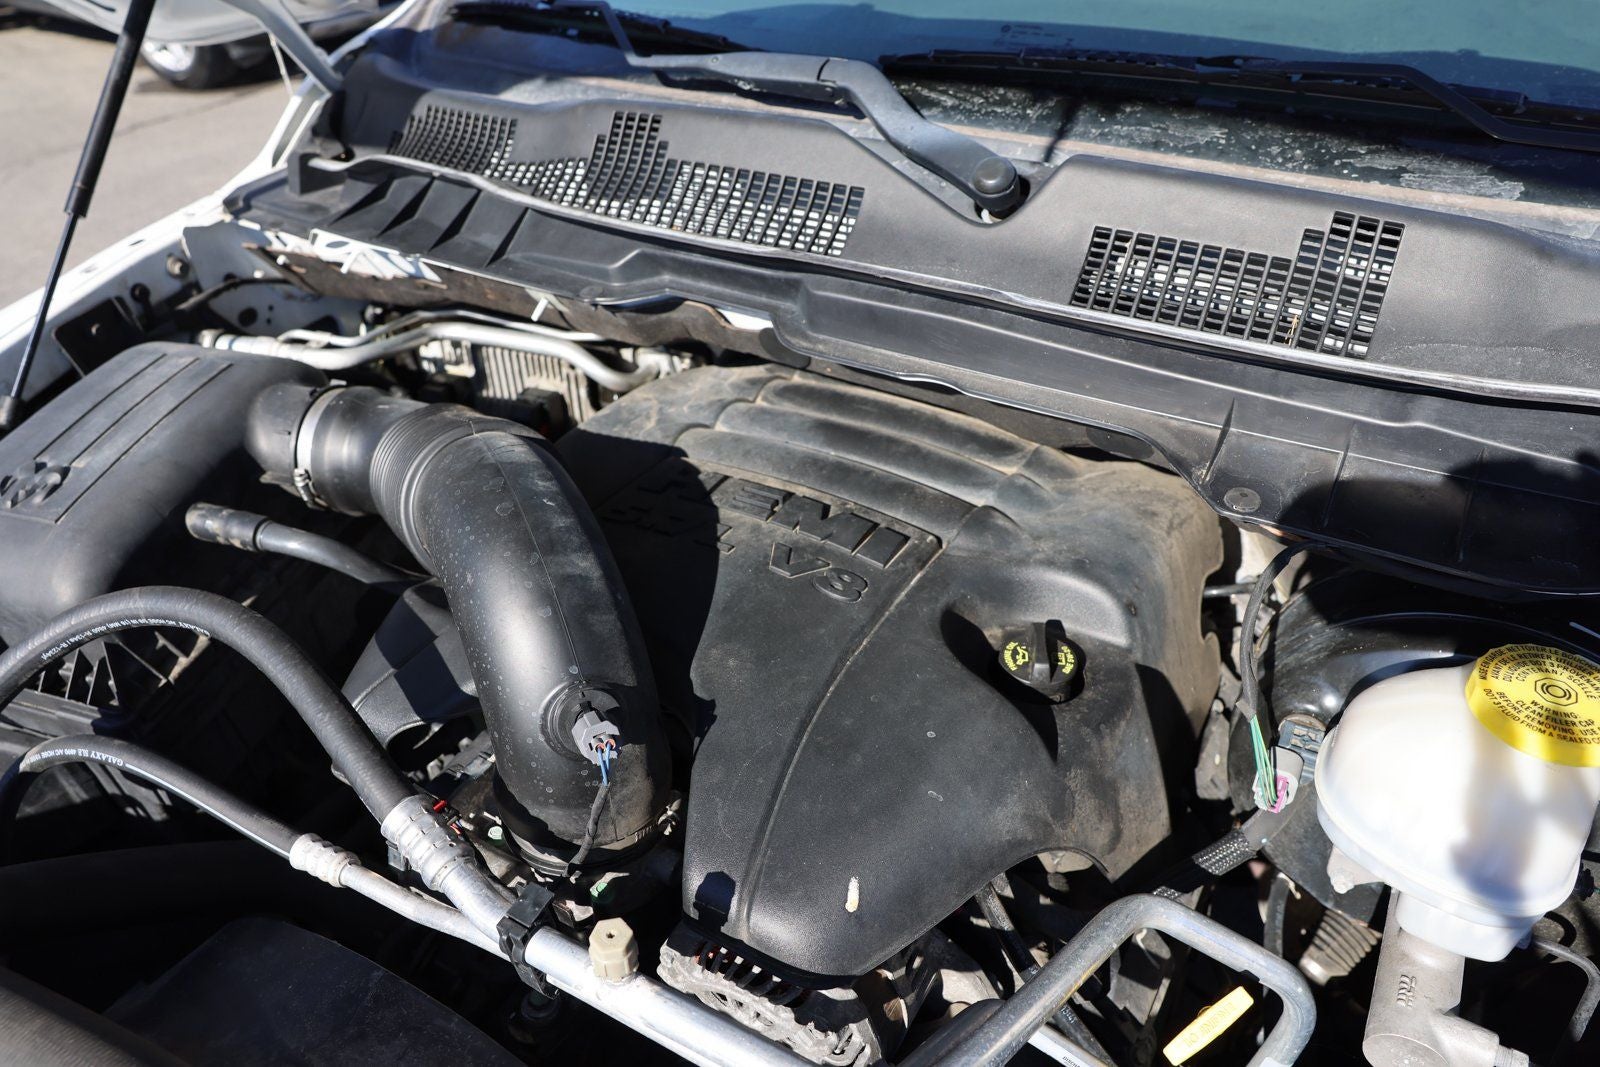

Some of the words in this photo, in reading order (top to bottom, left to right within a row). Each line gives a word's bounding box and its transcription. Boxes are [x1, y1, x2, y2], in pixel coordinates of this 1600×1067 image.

[769, 541, 868, 604] V8
[1006, 642, 1018, 650] OIL
[1004, 650, 1016, 671] ENGINE
[1062, 663, 1074, 674] SAE
[1556, 657, 1595, 676] UTILISER
[1515, 666, 1564, 682] CONTENANT
[1484, 688, 1498, 700] DOT
[1498, 705, 1520, 722] FLUID
[1520, 720, 1546, 735] FROM
[1557, 734, 1592, 744] SEALED
[1496, 692, 1524, 715] BEFORE
[1524, 714, 1578, 736] REMOVING.
[1516, 700, 1543, 718] CLEAN
[1546, 715, 1578, 728] FILLER
[1579, 718, 1595, 728] CAP
[41, 750, 55, 758] HOSE
[90, 750, 124, 766] GALAXY
